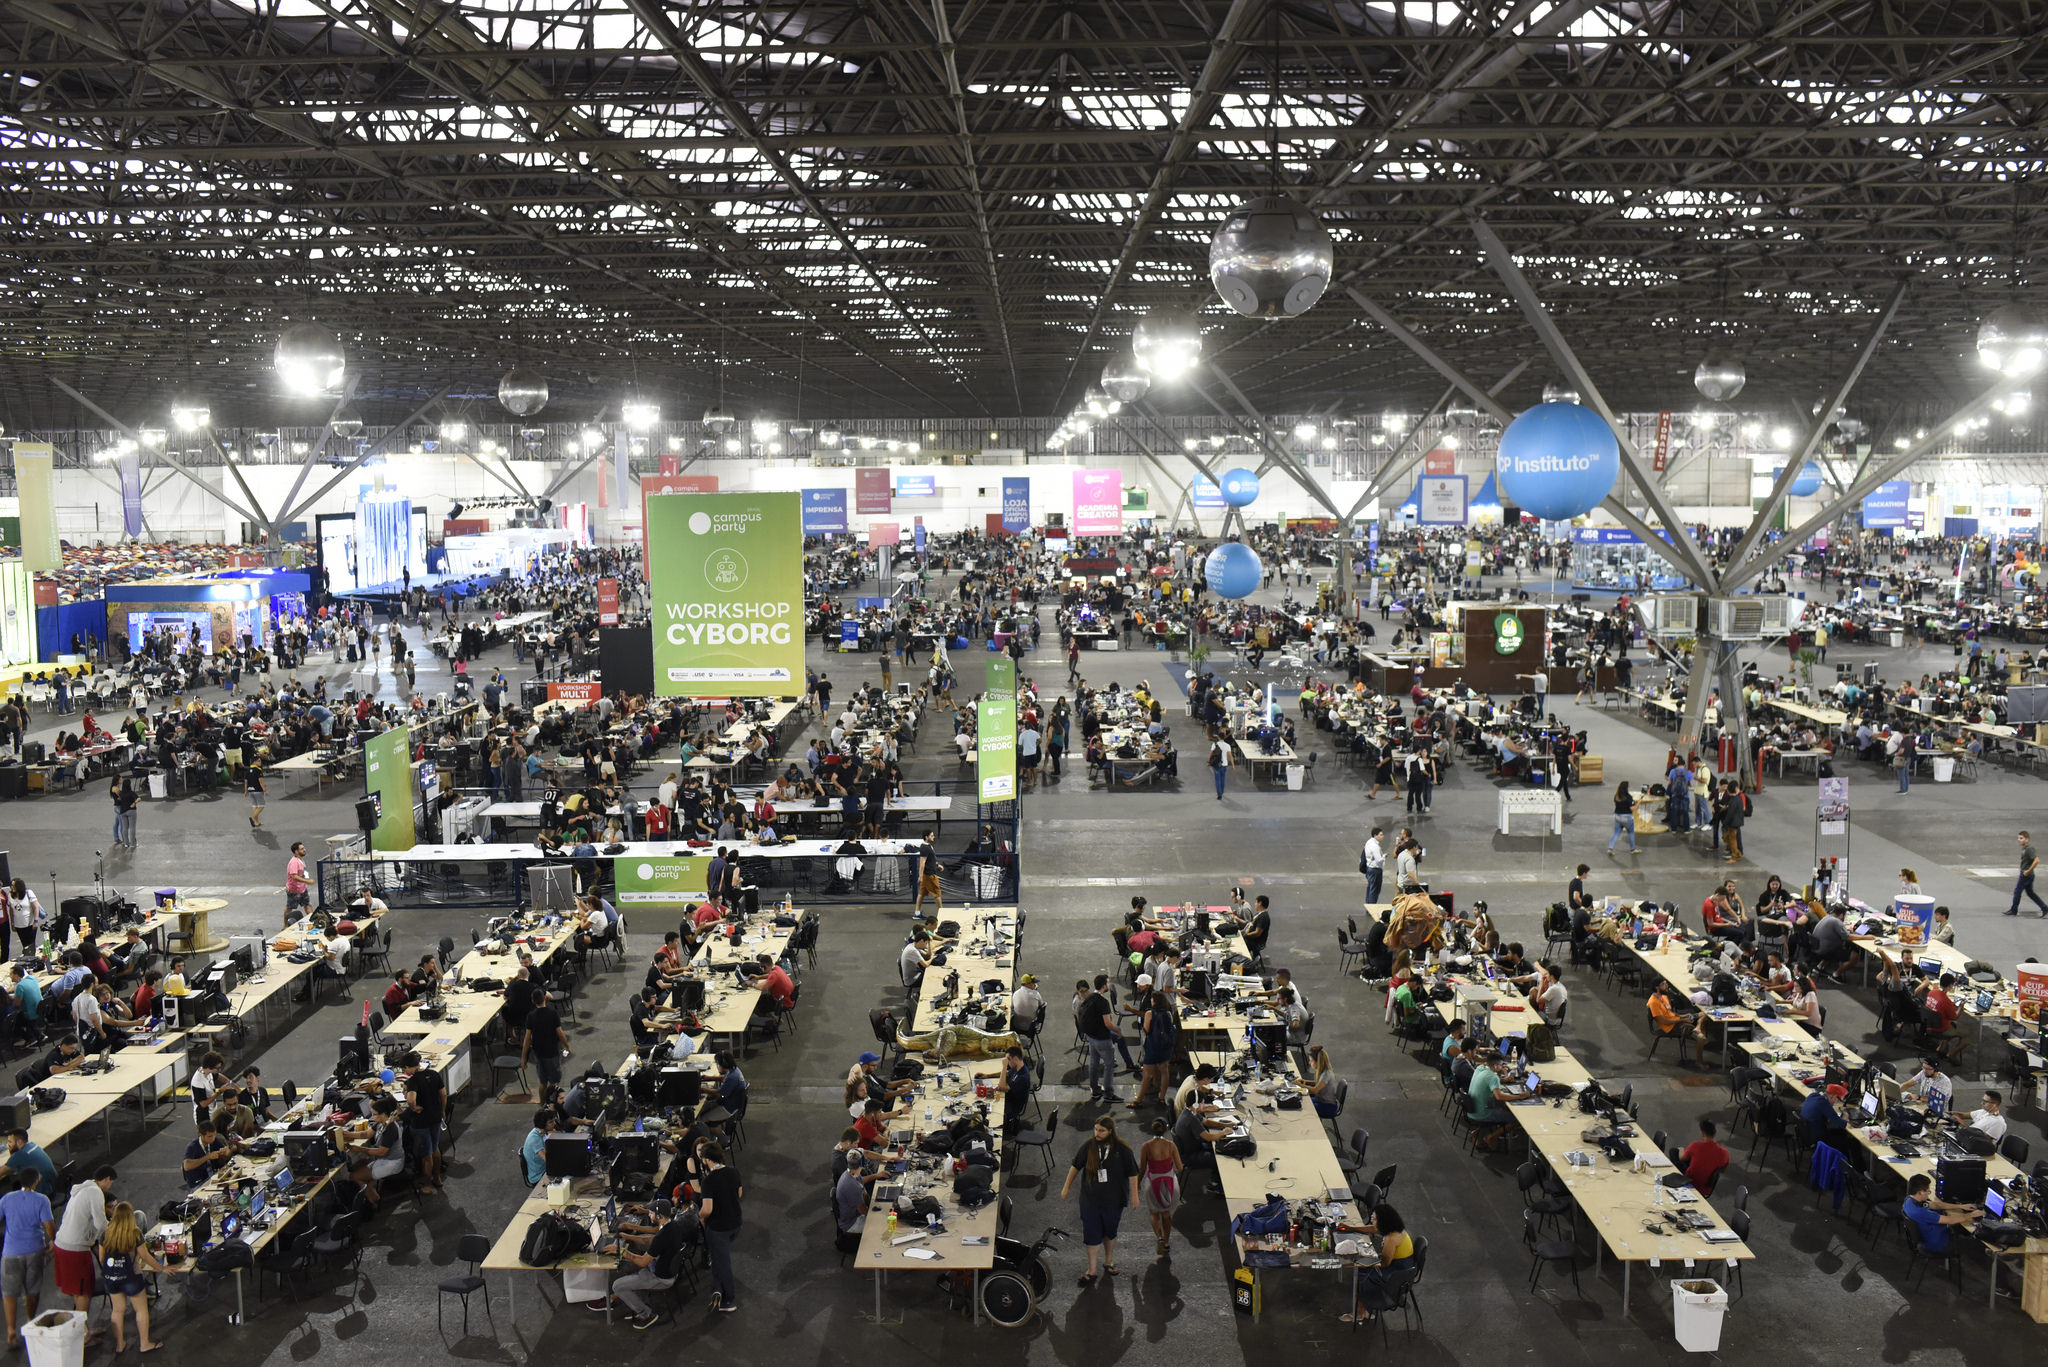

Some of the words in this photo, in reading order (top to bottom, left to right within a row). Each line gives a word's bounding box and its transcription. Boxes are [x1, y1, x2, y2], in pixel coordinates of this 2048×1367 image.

[1656, 413, 1670, 468] HIDRANTE
[1004, 499, 1027, 507] LOJA
[713, 512, 762, 523] campus
[713, 522, 746, 533] party
[666, 602, 790, 619] WORKSHOP
[667, 623, 791, 645] CYBORG
[990, 693, 1013, 701] CYBORG
[981, 735, 1012, 744] WORKSHOP
[981, 742, 1012, 752] CYBORG
[545, 790, 557, 801] 01
[2025, 981, 2045, 989] CUP
